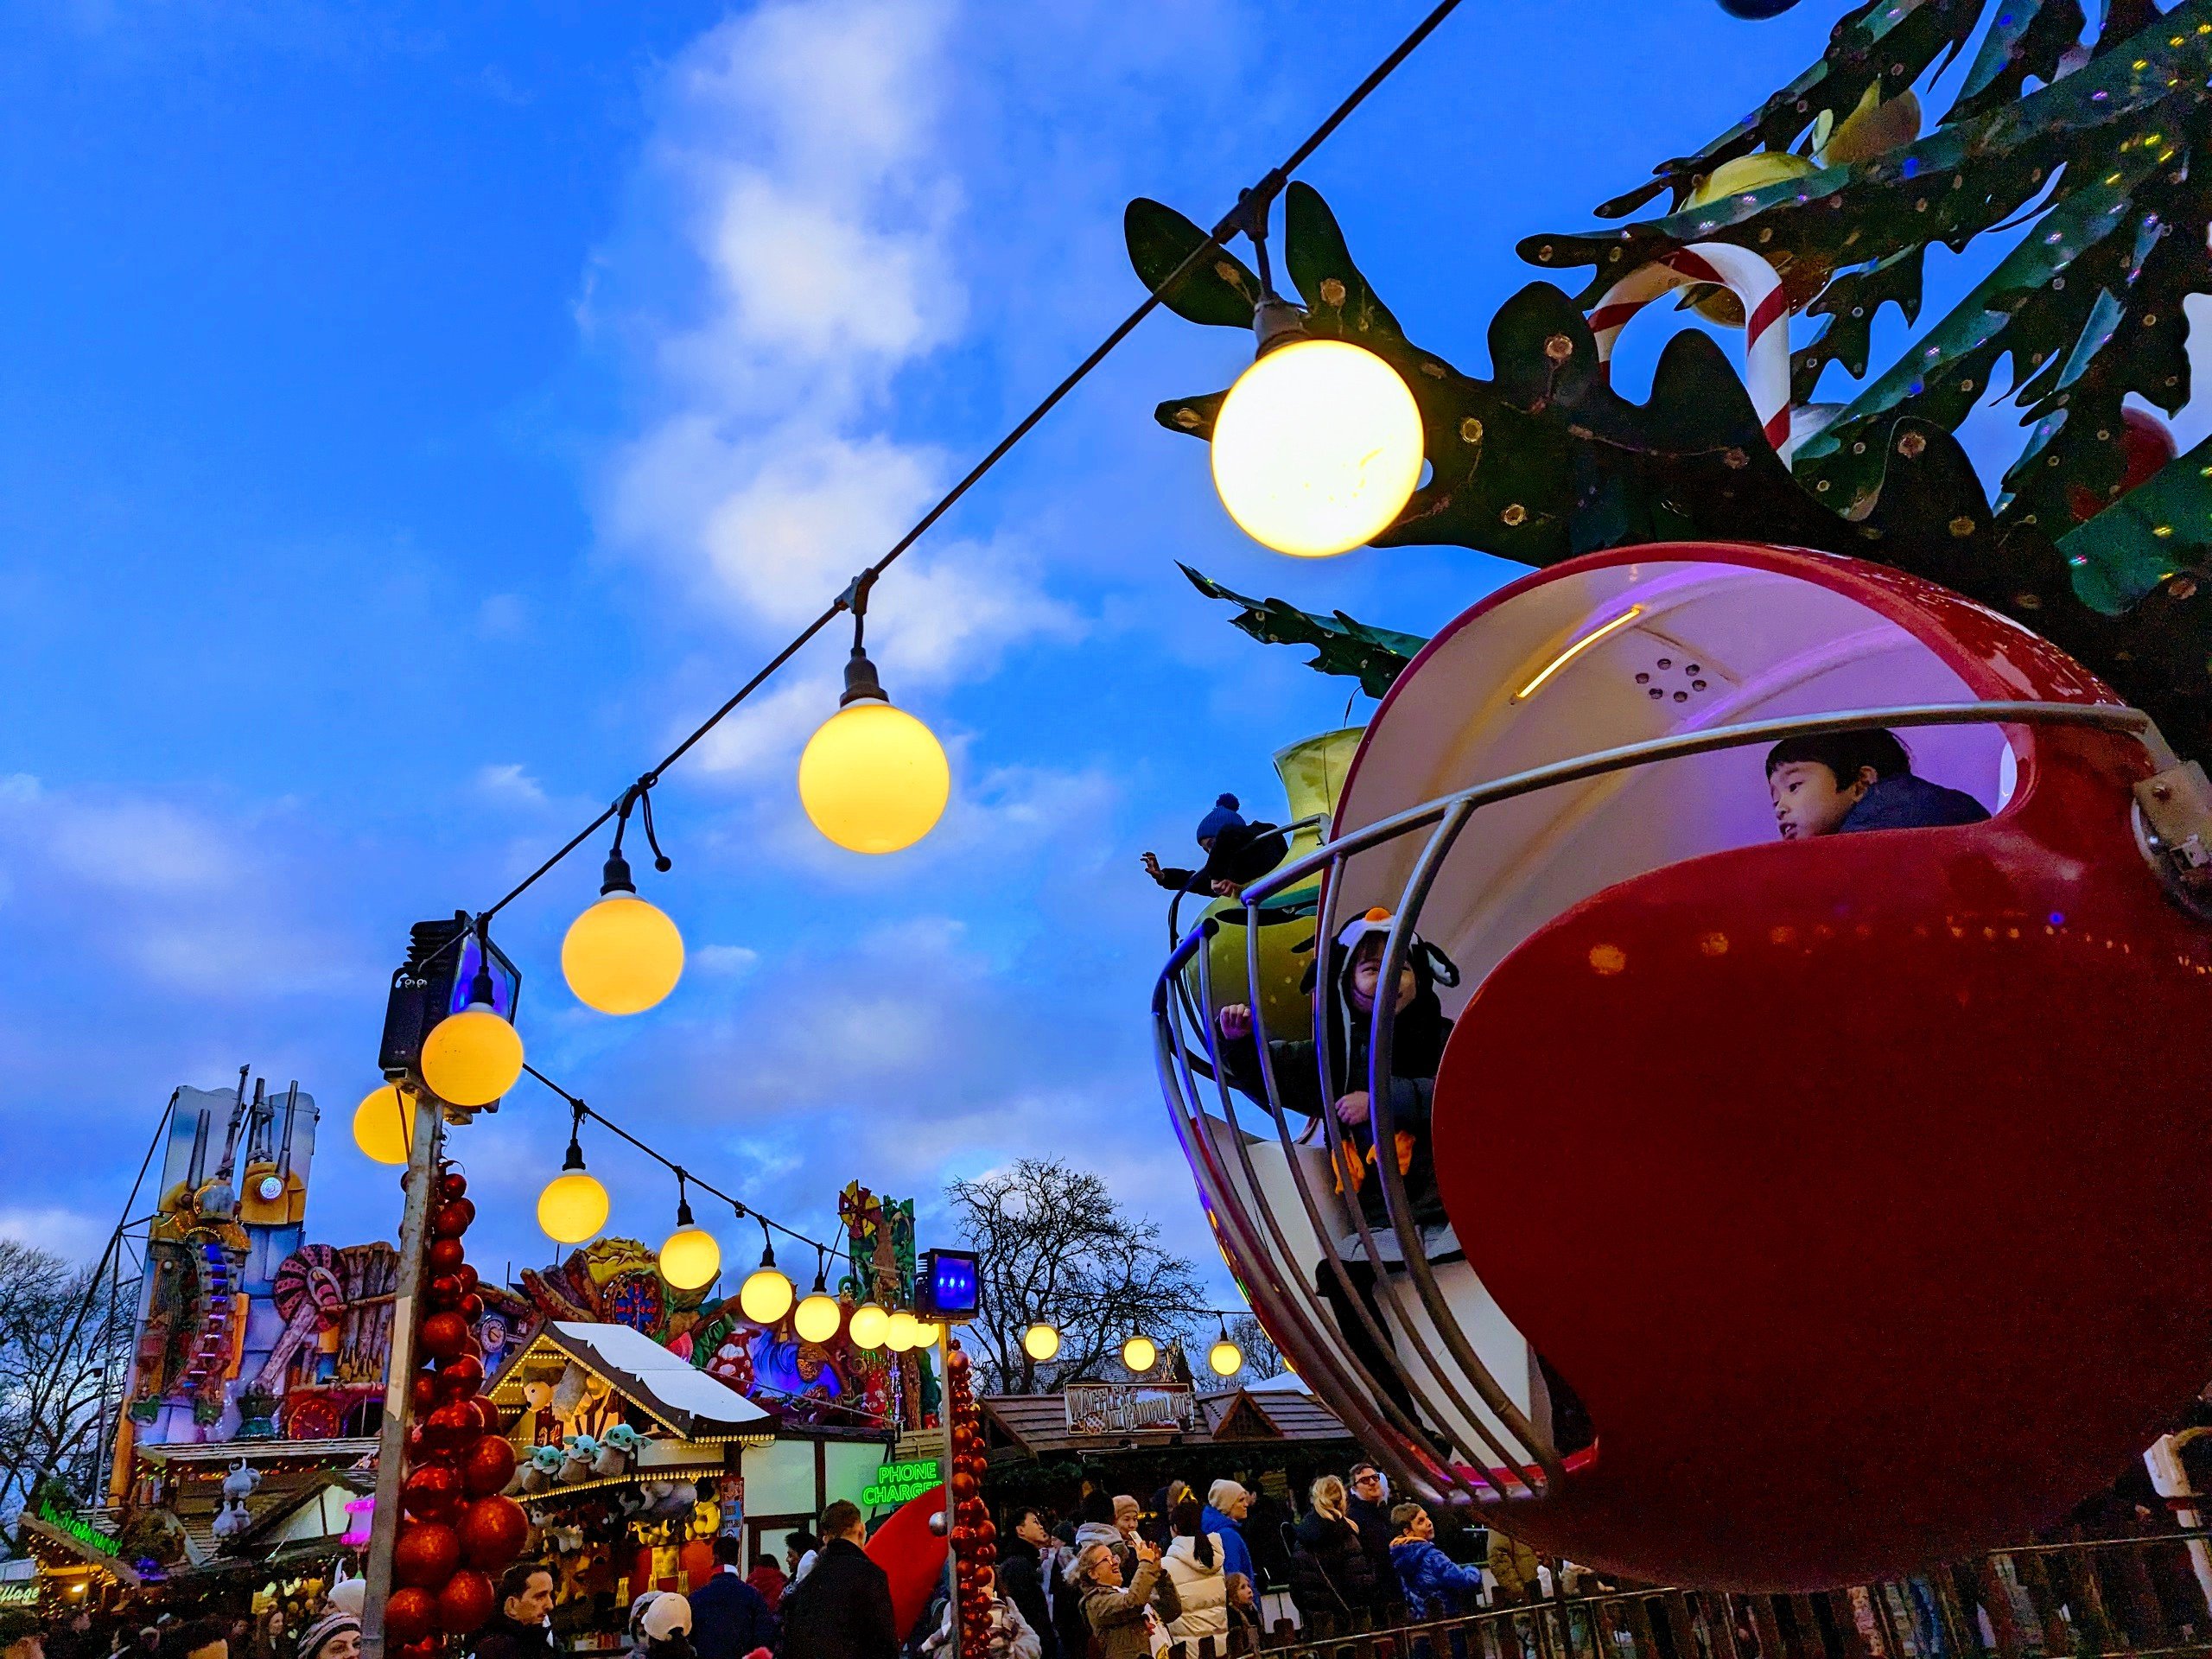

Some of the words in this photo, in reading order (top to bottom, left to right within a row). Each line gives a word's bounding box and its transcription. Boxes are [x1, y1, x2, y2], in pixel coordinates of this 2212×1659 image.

[1068, 1385, 1129, 1421] WAFFLES
[1122, 1391, 1193, 1432] CHOCOLATE
[879, 1462, 937, 1484] PHONE
[862, 1480, 944, 1504] CHARG
[0, 1585, 41, 1605] llage
